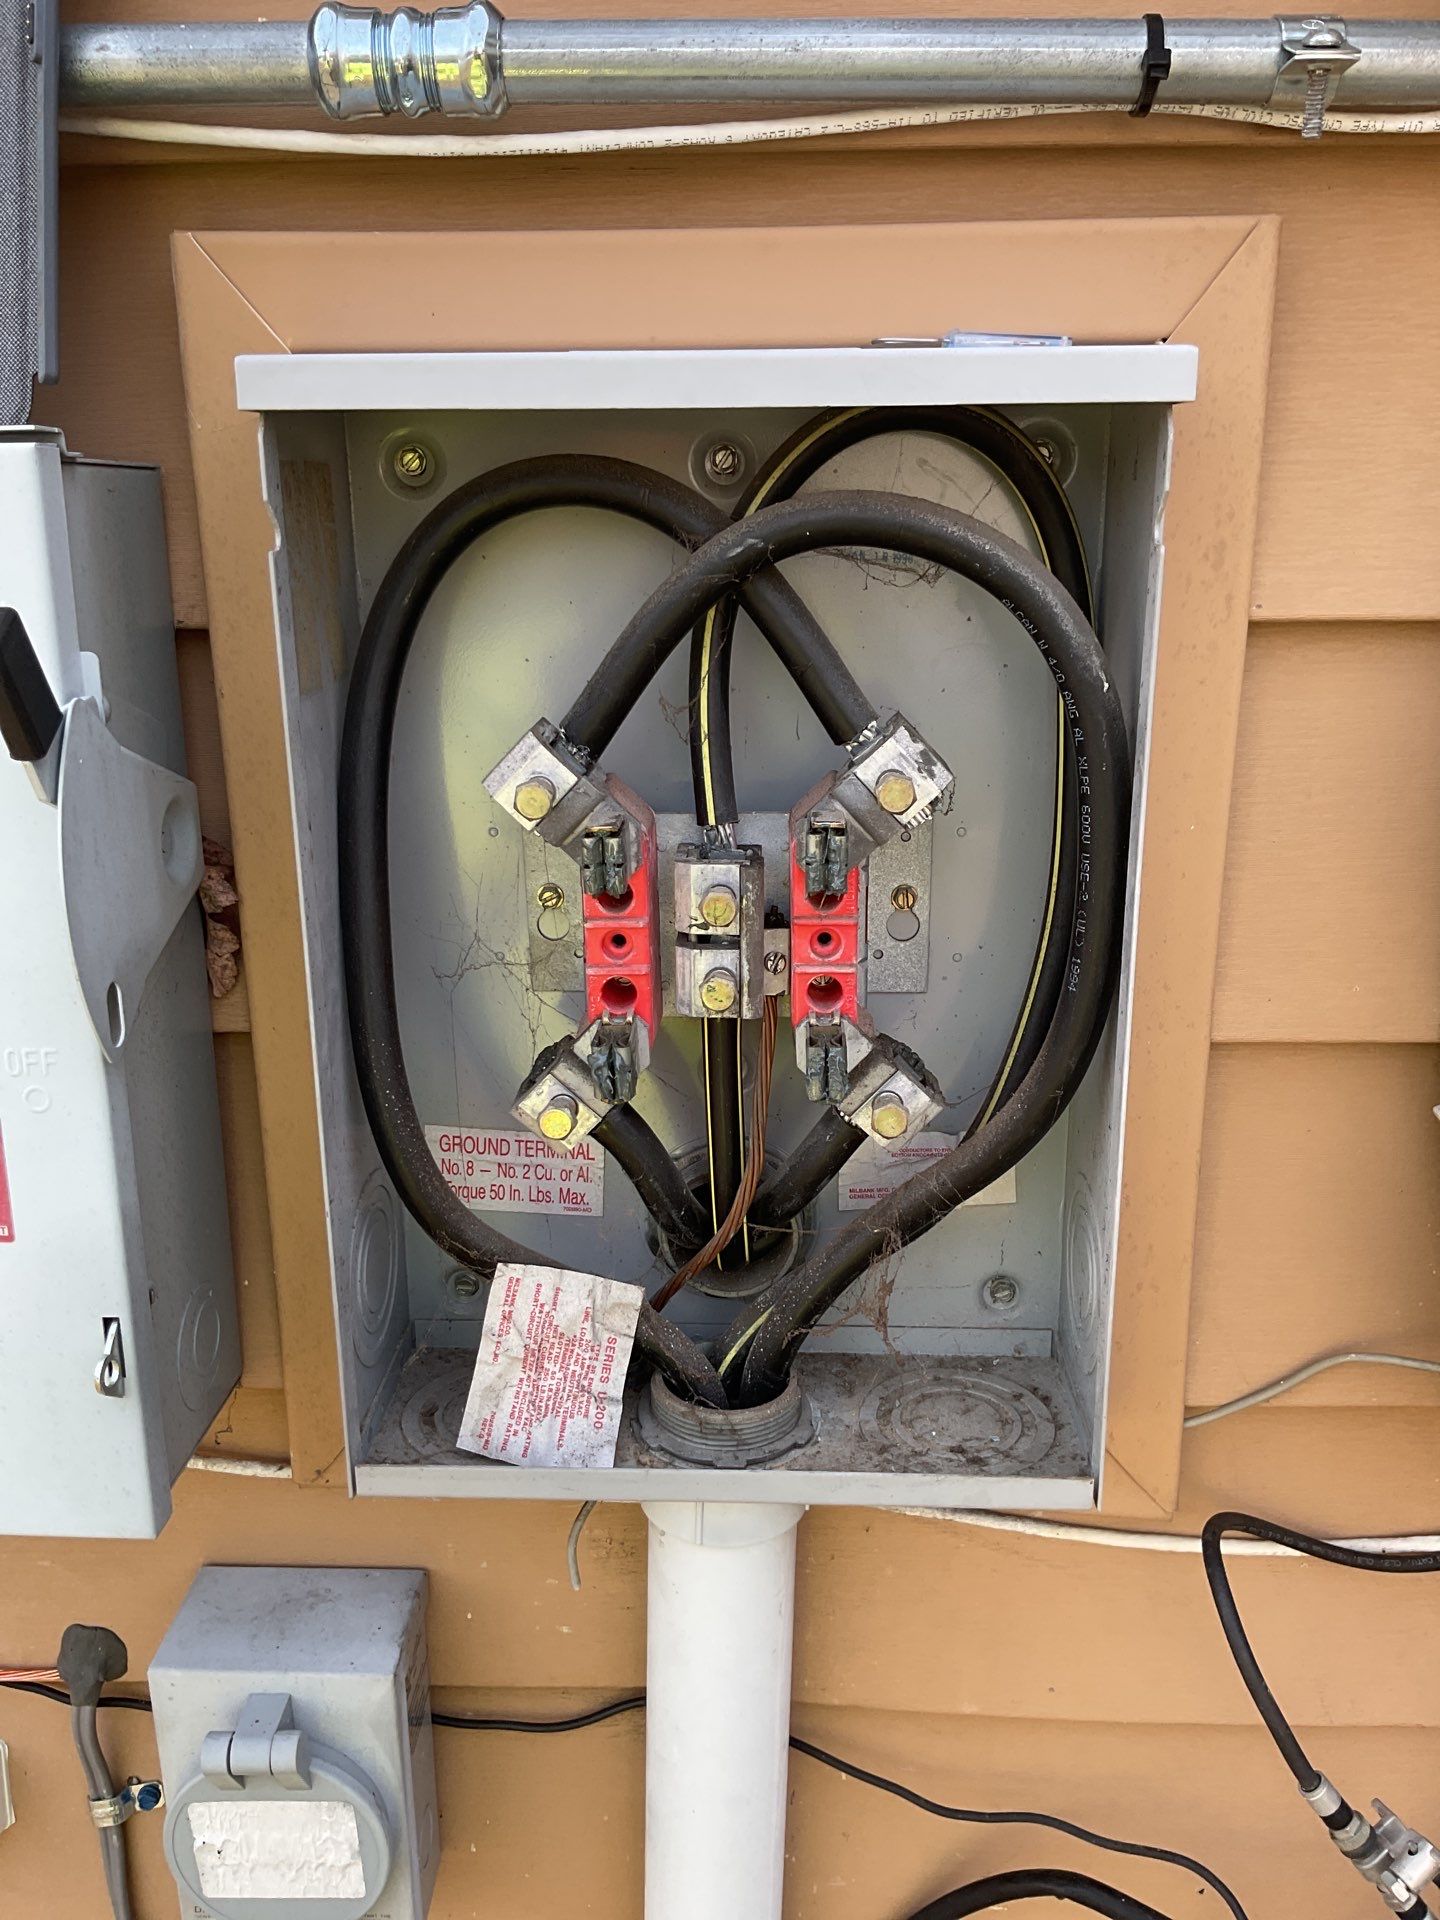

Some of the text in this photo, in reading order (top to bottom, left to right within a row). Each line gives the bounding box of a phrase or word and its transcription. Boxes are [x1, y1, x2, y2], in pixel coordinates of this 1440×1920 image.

[923, 112, 937, 126] TO
[950, 108, 1018, 122] VERIFIED
[1350, 120, 1384, 132] TYPE
[1048, 656, 1066, 683] 4/0
[1061, 690, 1079, 718] AWG
[1073, 728, 1082, 747] AL
[1078, 756, 1091, 795] XLPE
[1081, 804, 1091, 844] 600V
[1082, 853, 1090, 902] USE-2
[1068, 957, 1082, 992] 1994
[4, 1047, 57, 1077] OFF
[439, 1134, 596, 1160] GROUND TERMNAL
[441, 1158, 462, 1176] No.
[466, 1160, 474, 1176] 8
[497, 1162, 518, 1179] No.
[522, 1164, 530, 1180] 2
[534, 1164, 556, 1182] Cu.
[560, 1168, 574, 1182] or
[576, 1166, 593, 1184] Al.
[489, 1184, 506, 1200] 50
[509, 1186, 524, 1202] In.
[528, 1188, 554, 1204] Lbs.
[558, 1187, 590, 1206] Max.
[503, 1276, 515, 1307] GENERAL
[531, 1302, 545, 1345] WATTHOUR
[558, 1337, 570, 1373] TERMINAL
[572, 1352, 580, 1366] AND
[509, 1376, 524, 1420] WITHSTAND
[565, 1369, 577, 1402] NEUTRAL
[591, 1336, 617, 1430] SERIES U-200
[514, 1390, 528, 1426] INCLUDED
[512, 1428, 519, 1437] IN
